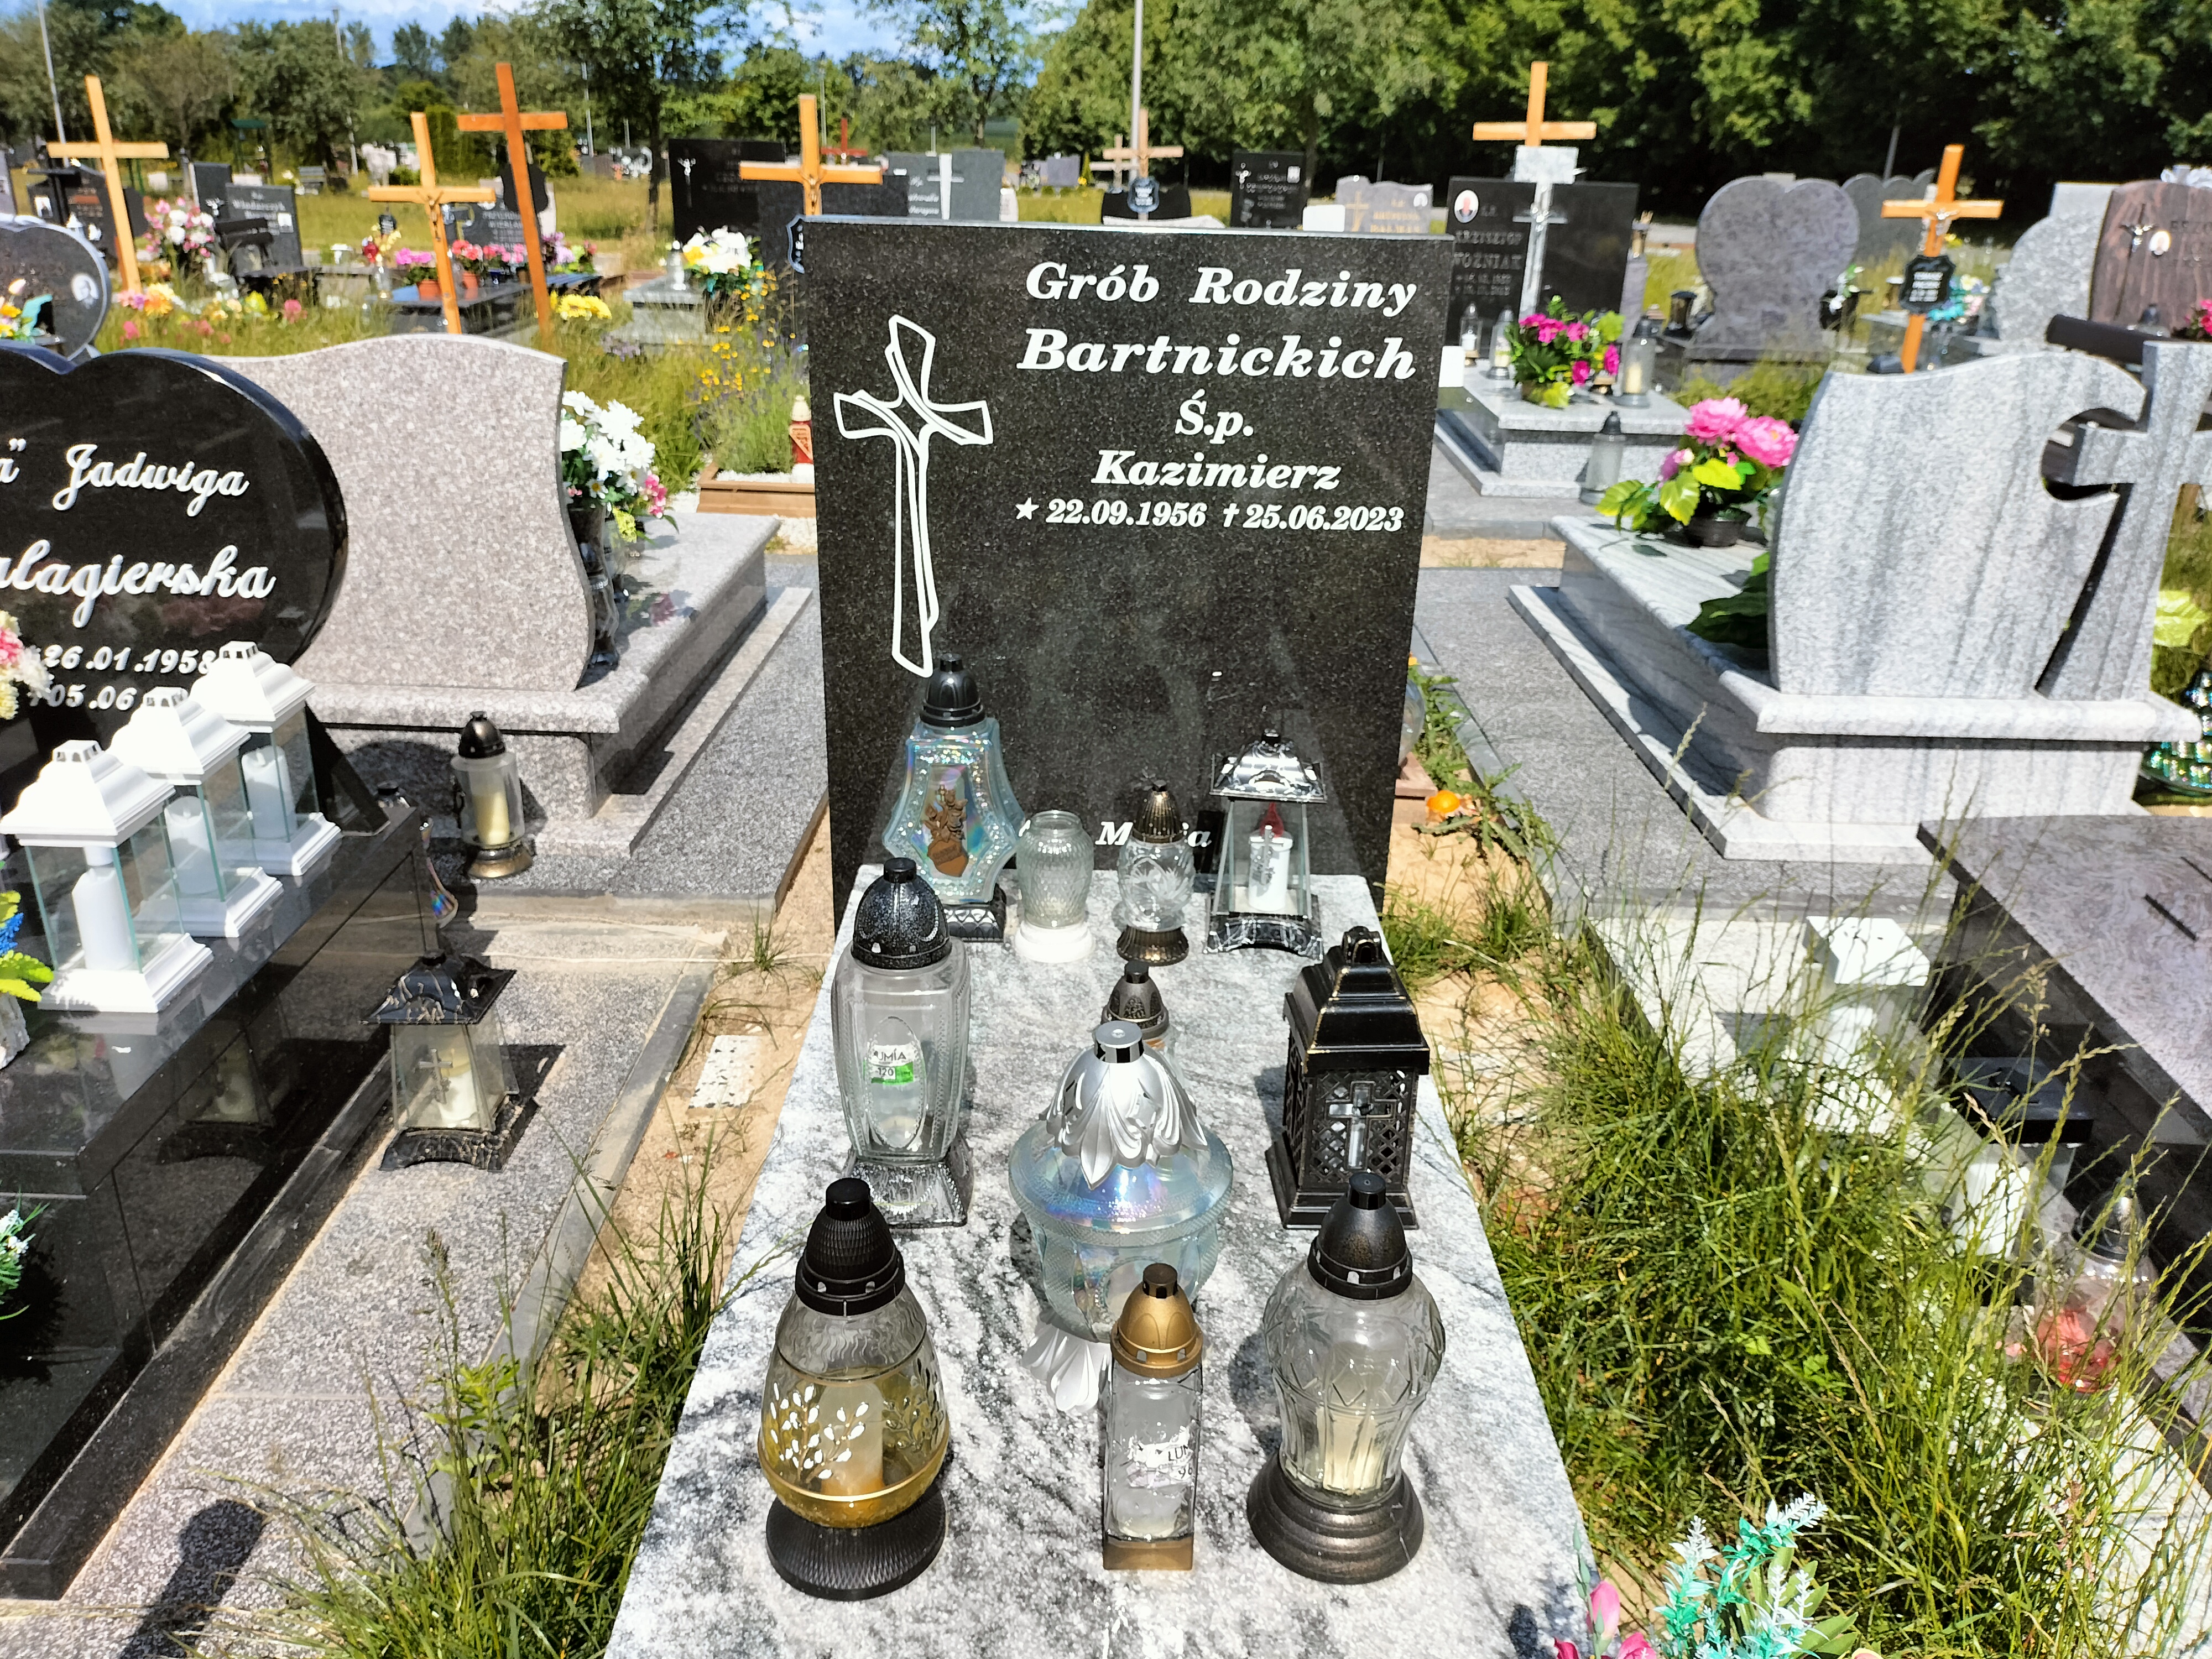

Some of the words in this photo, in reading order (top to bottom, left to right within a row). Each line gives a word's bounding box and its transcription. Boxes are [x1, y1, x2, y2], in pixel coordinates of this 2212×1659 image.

[1026, 261, 1160, 302] Grób
[1188, 267, 1417, 317] Rodziny
[1016, 327, 1416, 379] Bartnickich
[1175, 388, 1254, 445] Ś.p.
[52, 444, 250, 517] Jadwiga
[1091, 449, 1342, 490] Kazimierz
[1045, 498, 1208, 528] 22.09.1956
[1242, 503, 1405, 532] 25.06.2023
[873, 1048, 907, 1061] UMÍA
